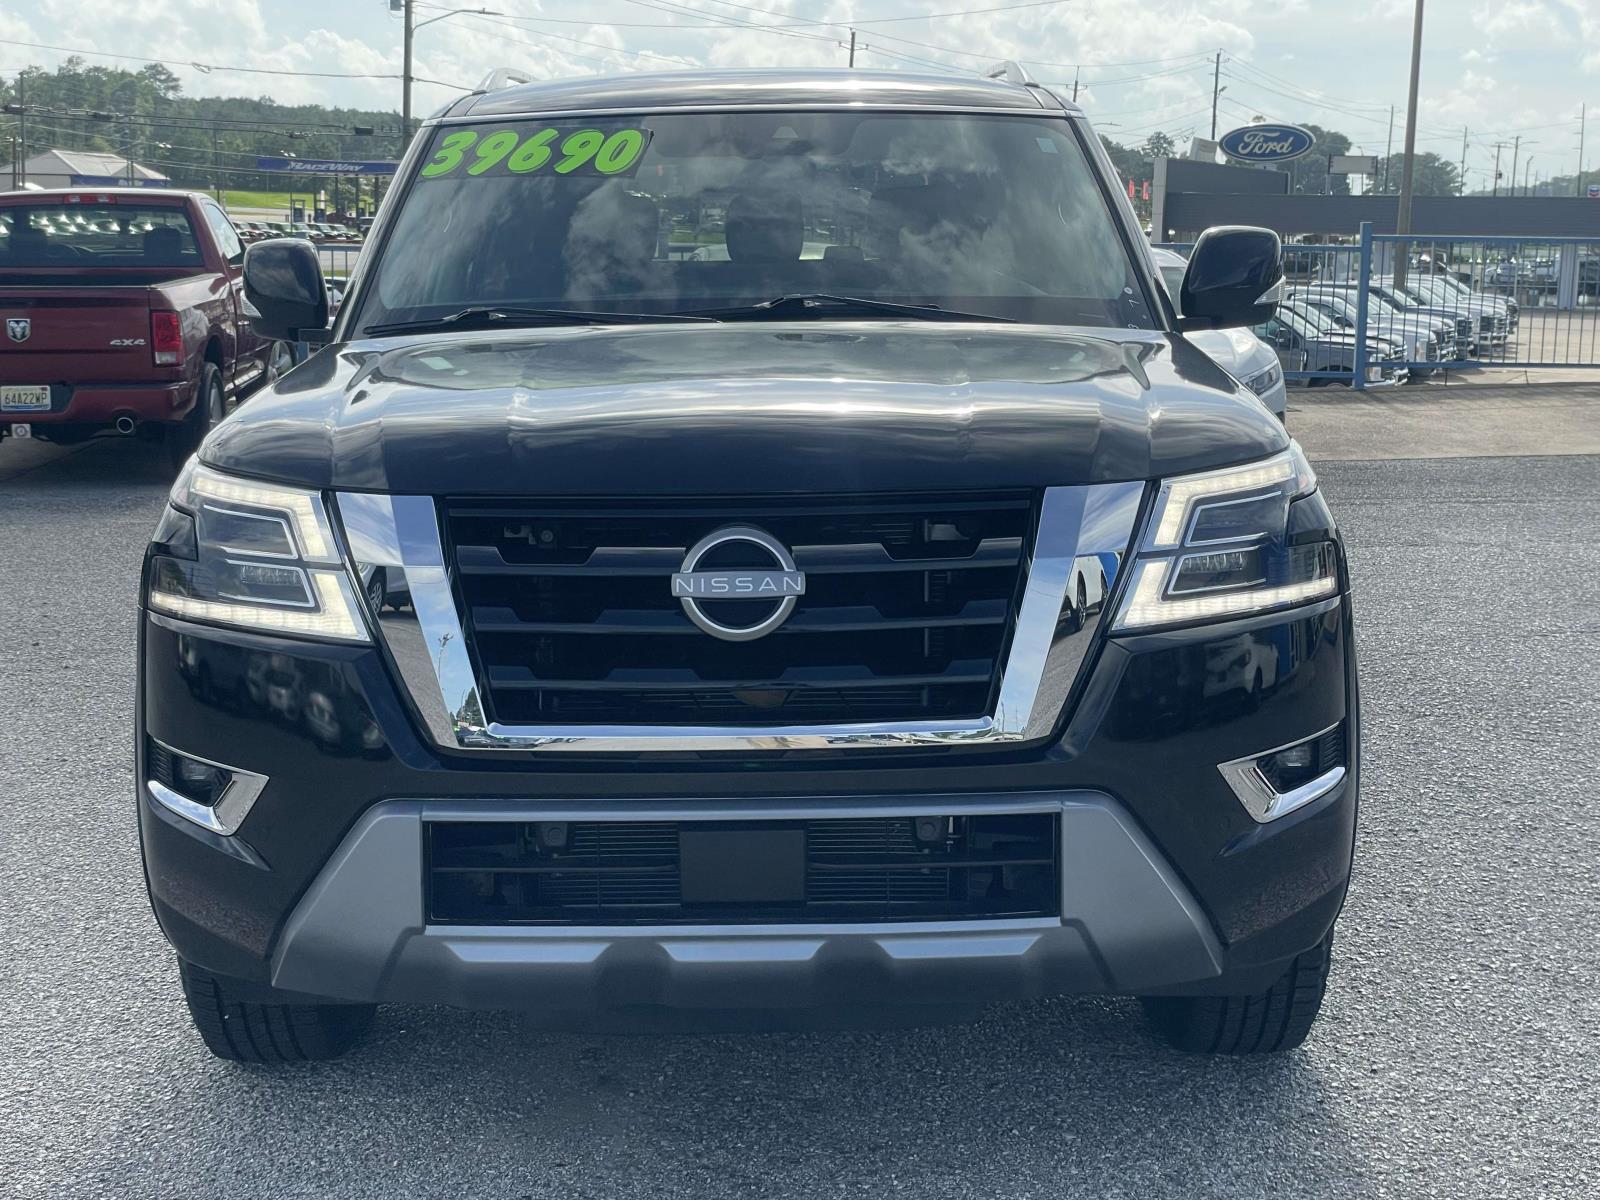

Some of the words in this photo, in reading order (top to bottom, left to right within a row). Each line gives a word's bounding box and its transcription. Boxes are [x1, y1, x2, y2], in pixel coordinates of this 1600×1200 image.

[421, 128, 644, 178] 39690
[1238, 131, 1294, 154] Ford
[676, 576, 801, 592] NISSAN
